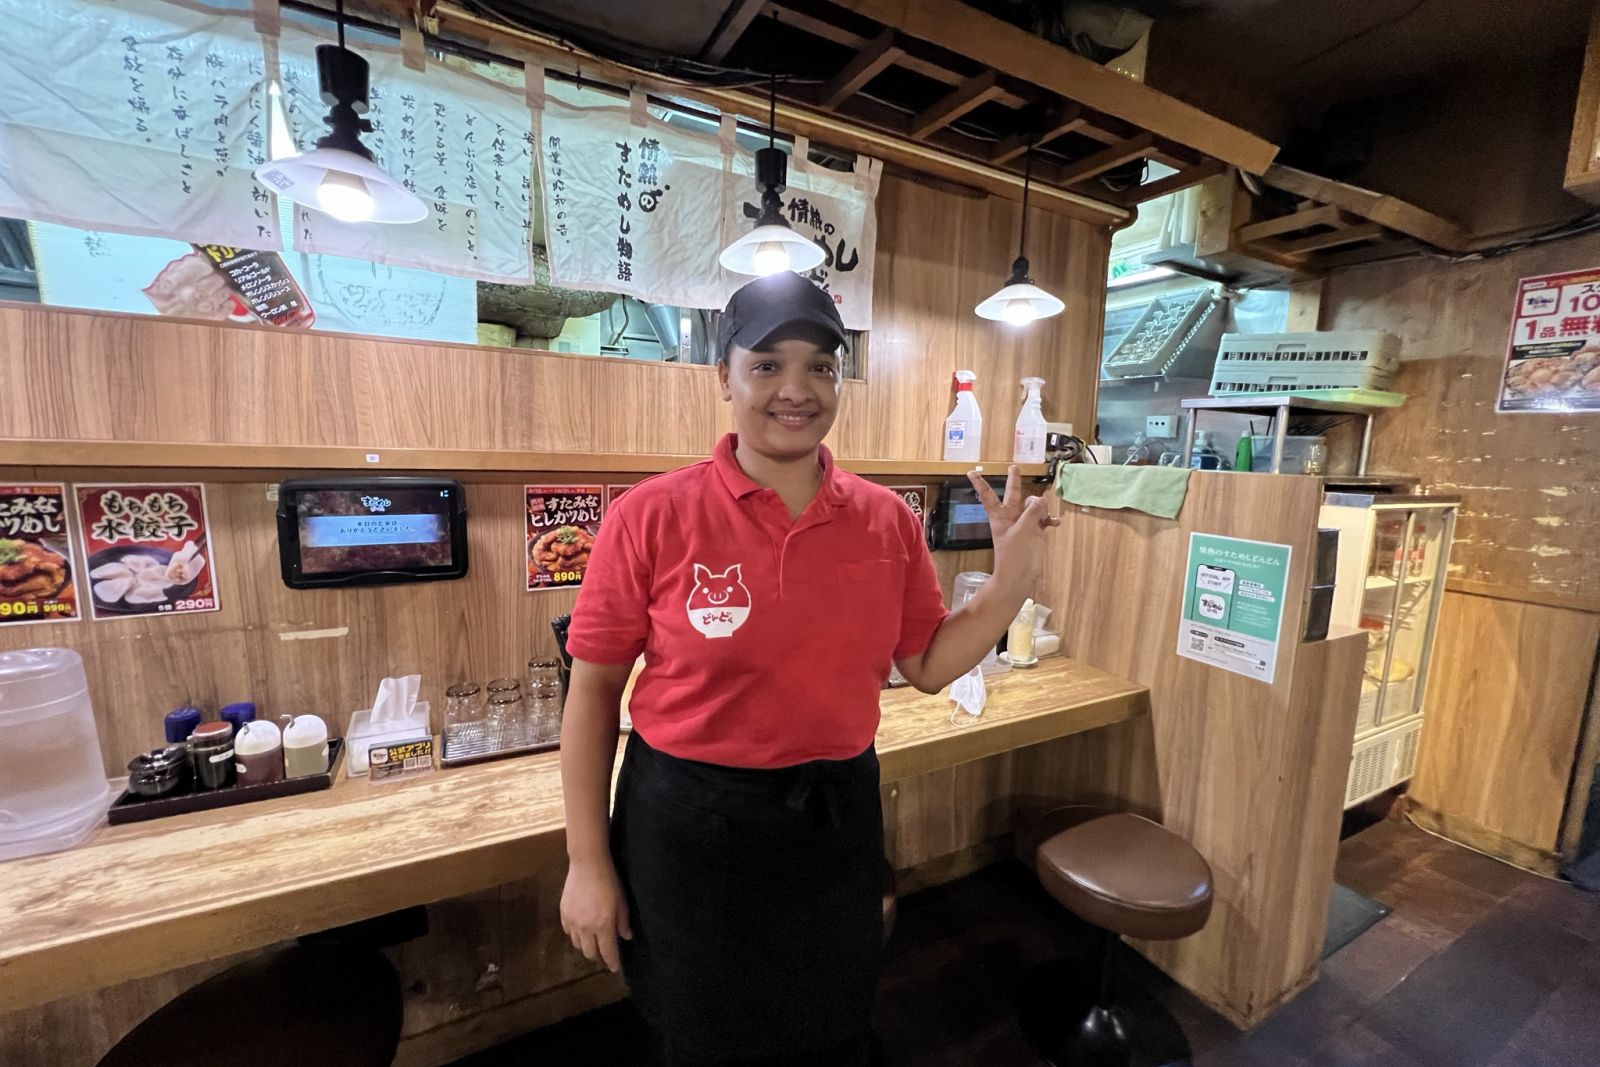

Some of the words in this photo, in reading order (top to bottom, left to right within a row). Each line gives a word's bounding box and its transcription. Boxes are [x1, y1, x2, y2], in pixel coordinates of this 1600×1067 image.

[615, 141, 633, 282] すためし物語
[101, 490, 187, 515] もちもち
[545, 494, 598, 512] すたみな
[92, 513, 198, 543] 水餃子
[702, 611, 733, 625] どんどん
